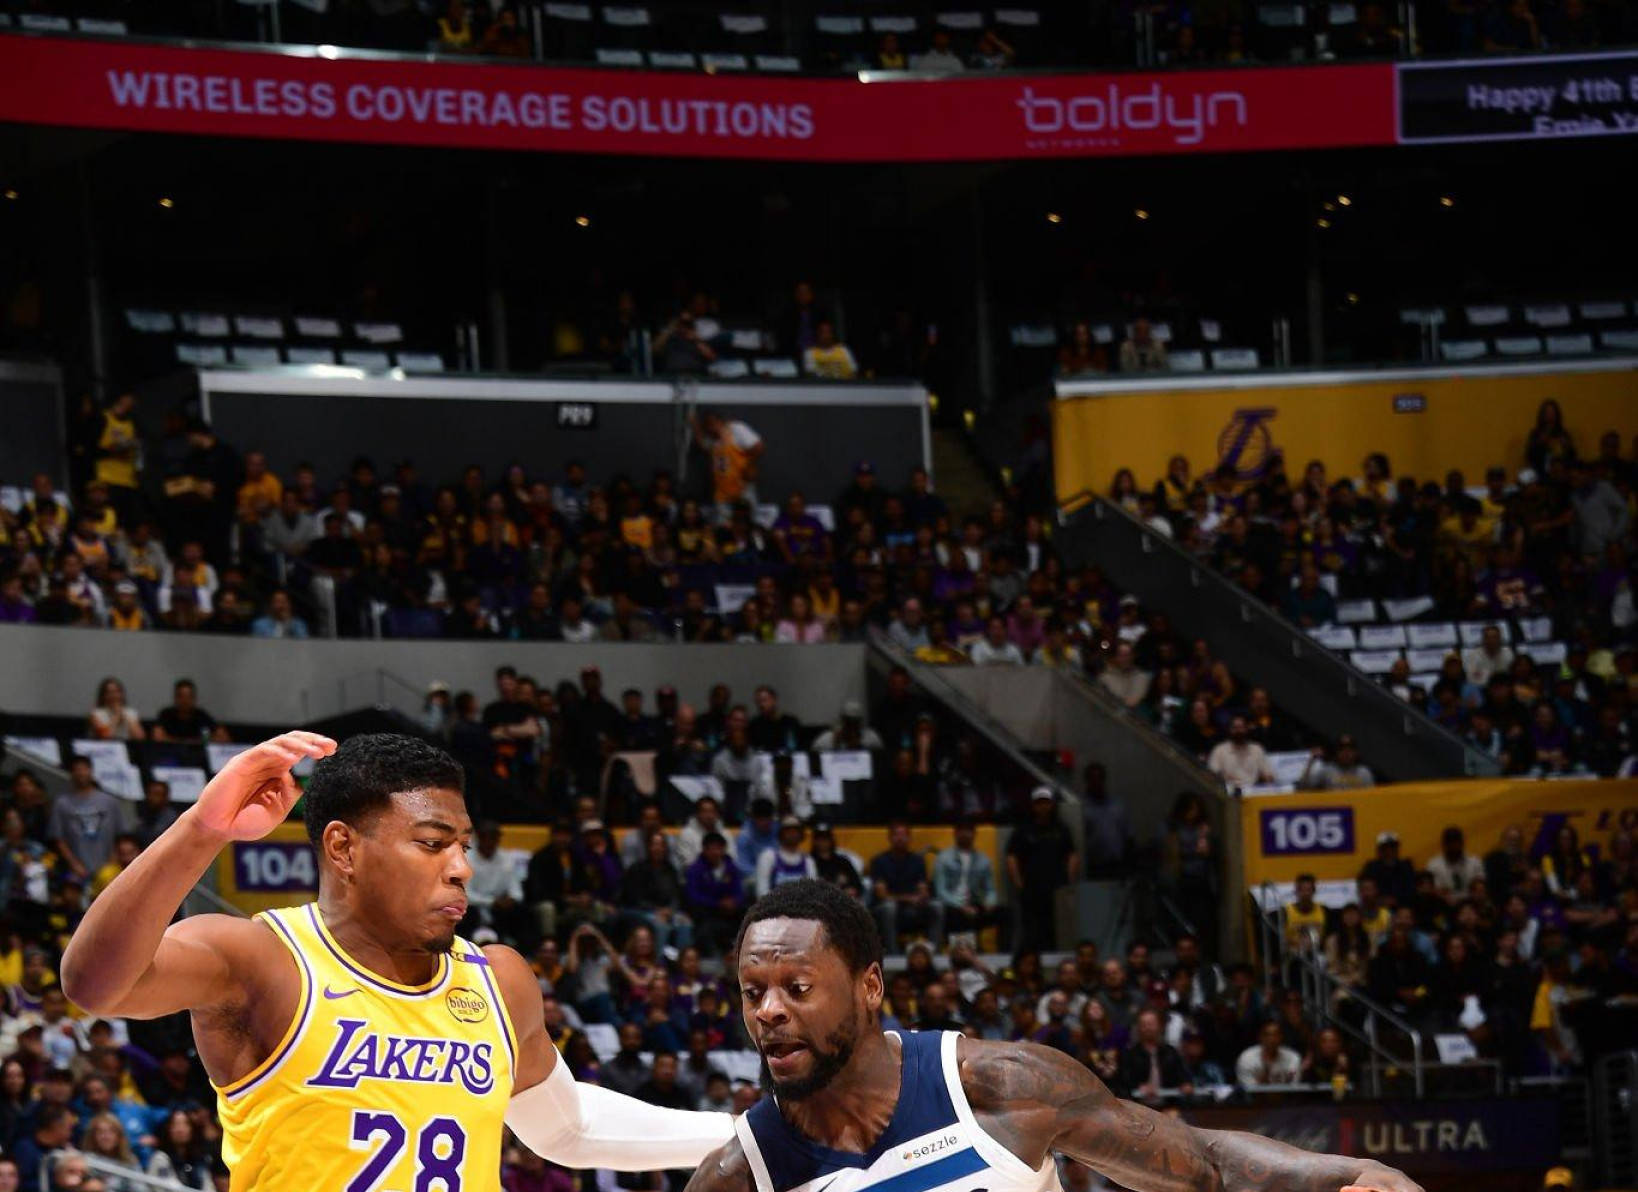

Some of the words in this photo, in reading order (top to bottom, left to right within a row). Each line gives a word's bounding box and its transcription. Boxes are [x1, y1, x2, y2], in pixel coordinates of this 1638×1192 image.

[107, 70, 337, 118] WIRELESS
[348, 84, 572, 130] COVERAGE
[581, 96, 814, 139] SOLUTIONS
[1017, 83, 1247, 144] boldyn
[1467, 84, 1554, 112] Happy
[1269, 815, 1344, 849] 105
[242, 848, 314, 886] 104
[448, 996, 485, 1013] bibigo
[306, 1018, 495, 1096] LAKERS
[912, 1135, 958, 1159] sezzle
[1363, 1121, 1488, 1153] ULTRA
